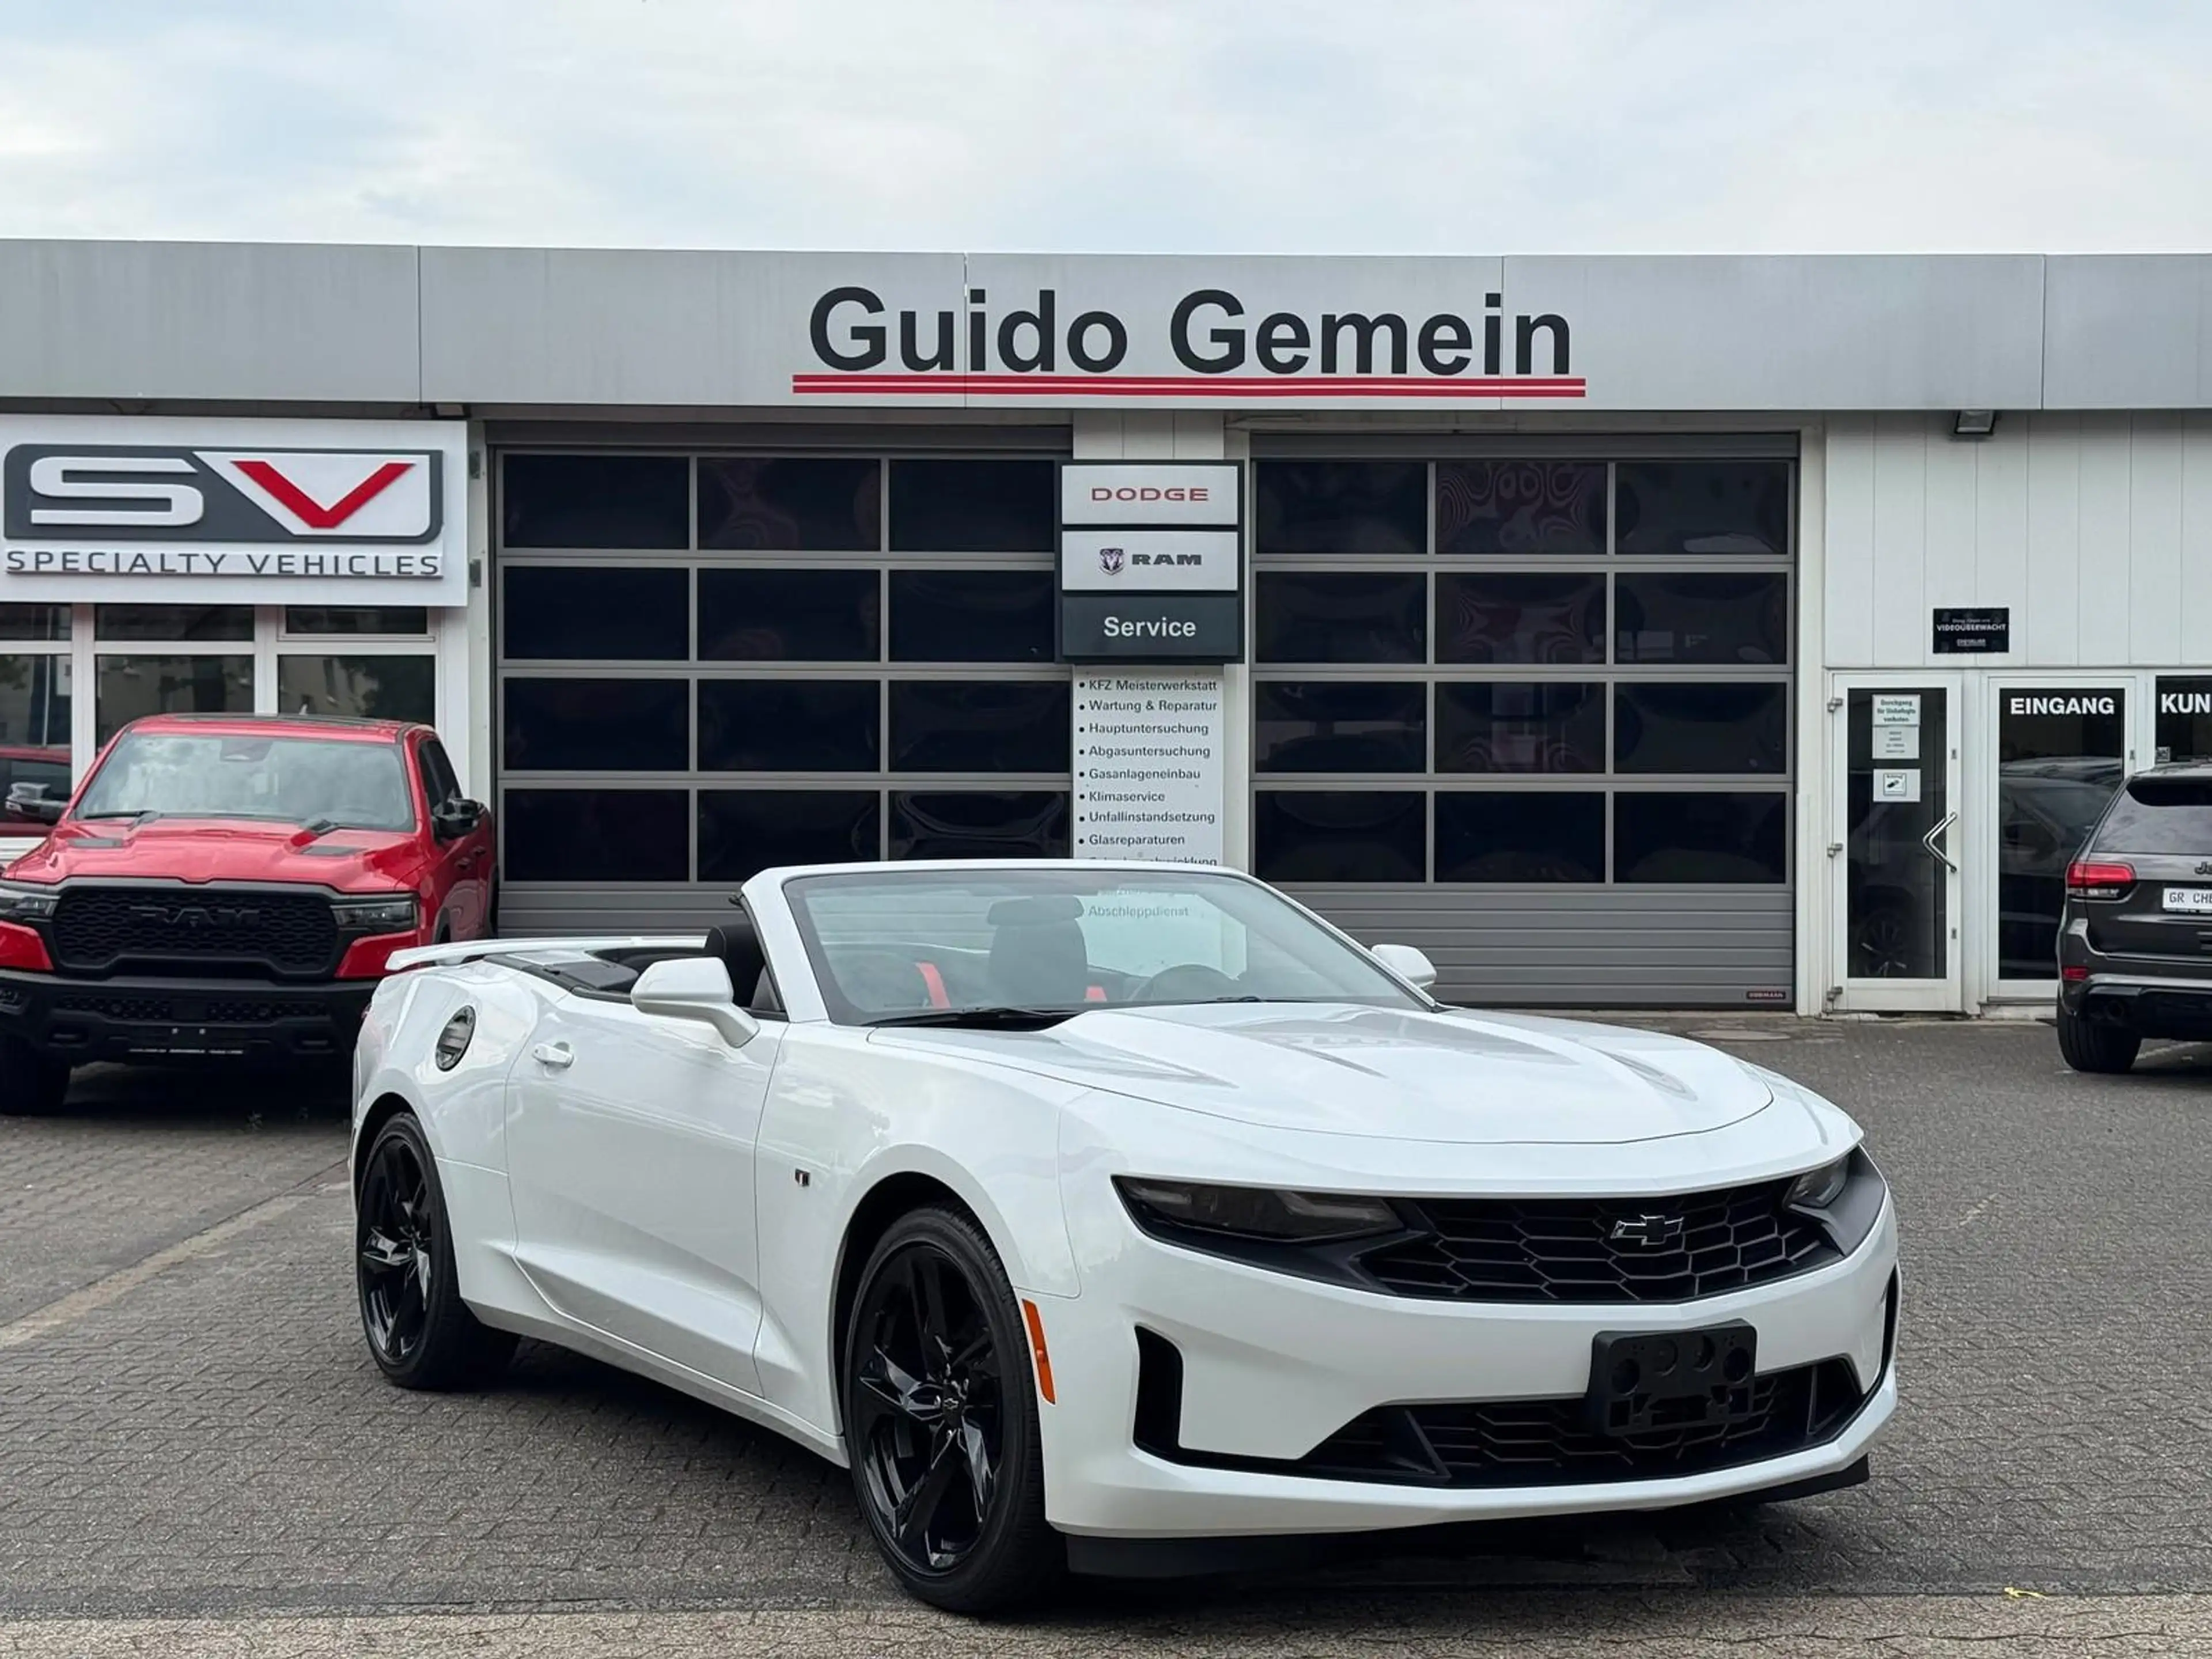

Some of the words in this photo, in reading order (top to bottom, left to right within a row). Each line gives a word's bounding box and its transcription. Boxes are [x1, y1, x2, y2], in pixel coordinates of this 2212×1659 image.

[809, 287, 1127, 372] Guido
[1170, 289, 1570, 374] Gemein
[30, 456, 416, 528] SV
[1092, 487, 1209, 501] DODGE
[6, 551, 227, 574] SPECIALTY
[247, 554, 440, 575] VEHICLES
[1131, 554, 1202, 565] RAM
[1103, 616, 1196, 637] Service
[1089, 680, 1112, 691] KFZ
[1116, 680, 1217, 691] Meisterwerkstatt
[1089, 700, 1142, 713] Wartung
[1145, 700, 1154, 711] &
[1158, 700, 1217, 712] Reparatur
[2010, 697, 2115, 715] EINGANG
[1089, 723, 1209, 736] Hauptuntersuchung
[1089, 746, 1211, 759] Abgasuntersuchung
[1089, 768, 1201, 781] Gasanlageneinbau
[1089, 791, 1165, 802] Klimaservice
[1089, 812, 1215, 824] Unfallinstandsetzung
[1089, 834, 1185, 847] Glasreparaturen
[2169, 892, 2185, 903] GR
